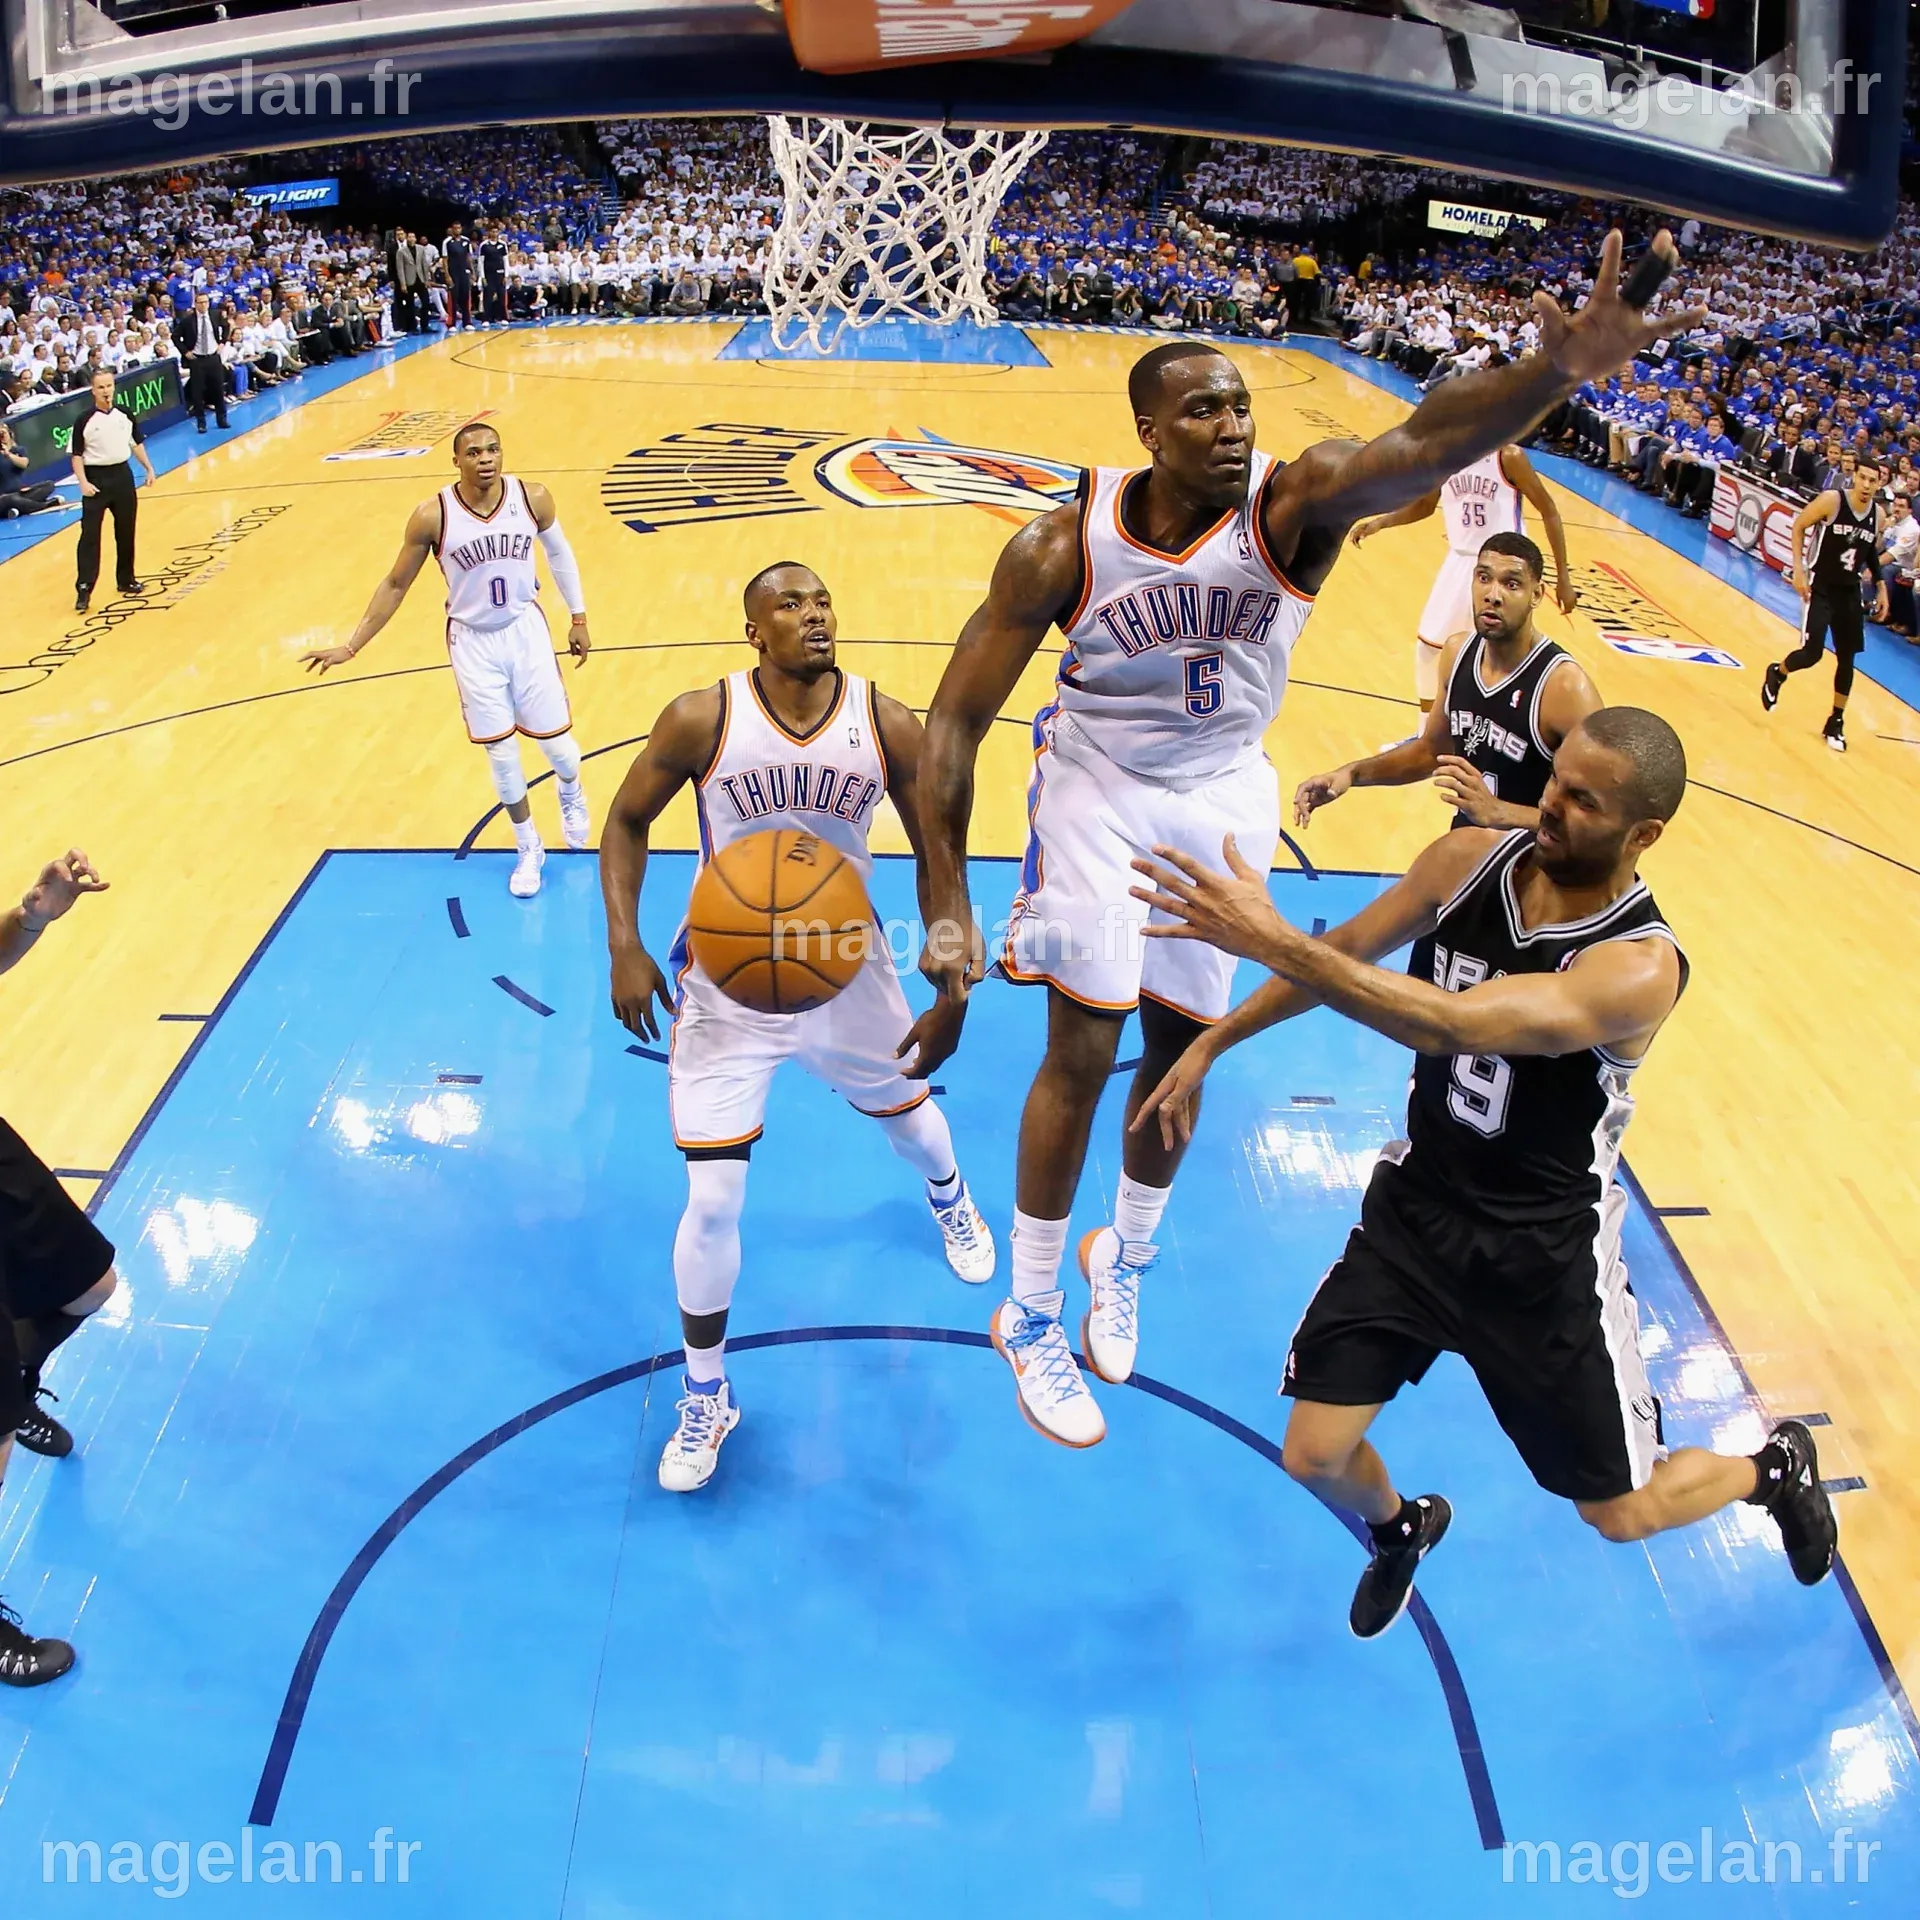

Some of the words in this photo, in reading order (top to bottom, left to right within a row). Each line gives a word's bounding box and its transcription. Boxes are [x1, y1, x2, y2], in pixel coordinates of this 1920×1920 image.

[277, 187, 331, 203] LIGHT
[1442, 206, 1507, 228] HOMELA
[600, 423, 851, 533] THUNDER
[1448, 474, 1499, 500] THUNDER
[174, 504, 292, 553] Arena
[1462, 502, 1486, 526] 35
[1833, 524, 1875, 544] SPURS
[450, 533, 532, 572] THUNDER
[1840, 548, 1857, 571] 4
[488, 576, 509, 609] 0
[1095, 583, 1282, 658] THUNDER
[1184, 651, 1224, 718] 5
[719, 763, 880, 823] THUNDER
[1446, 1053, 1516, 1139] 9
